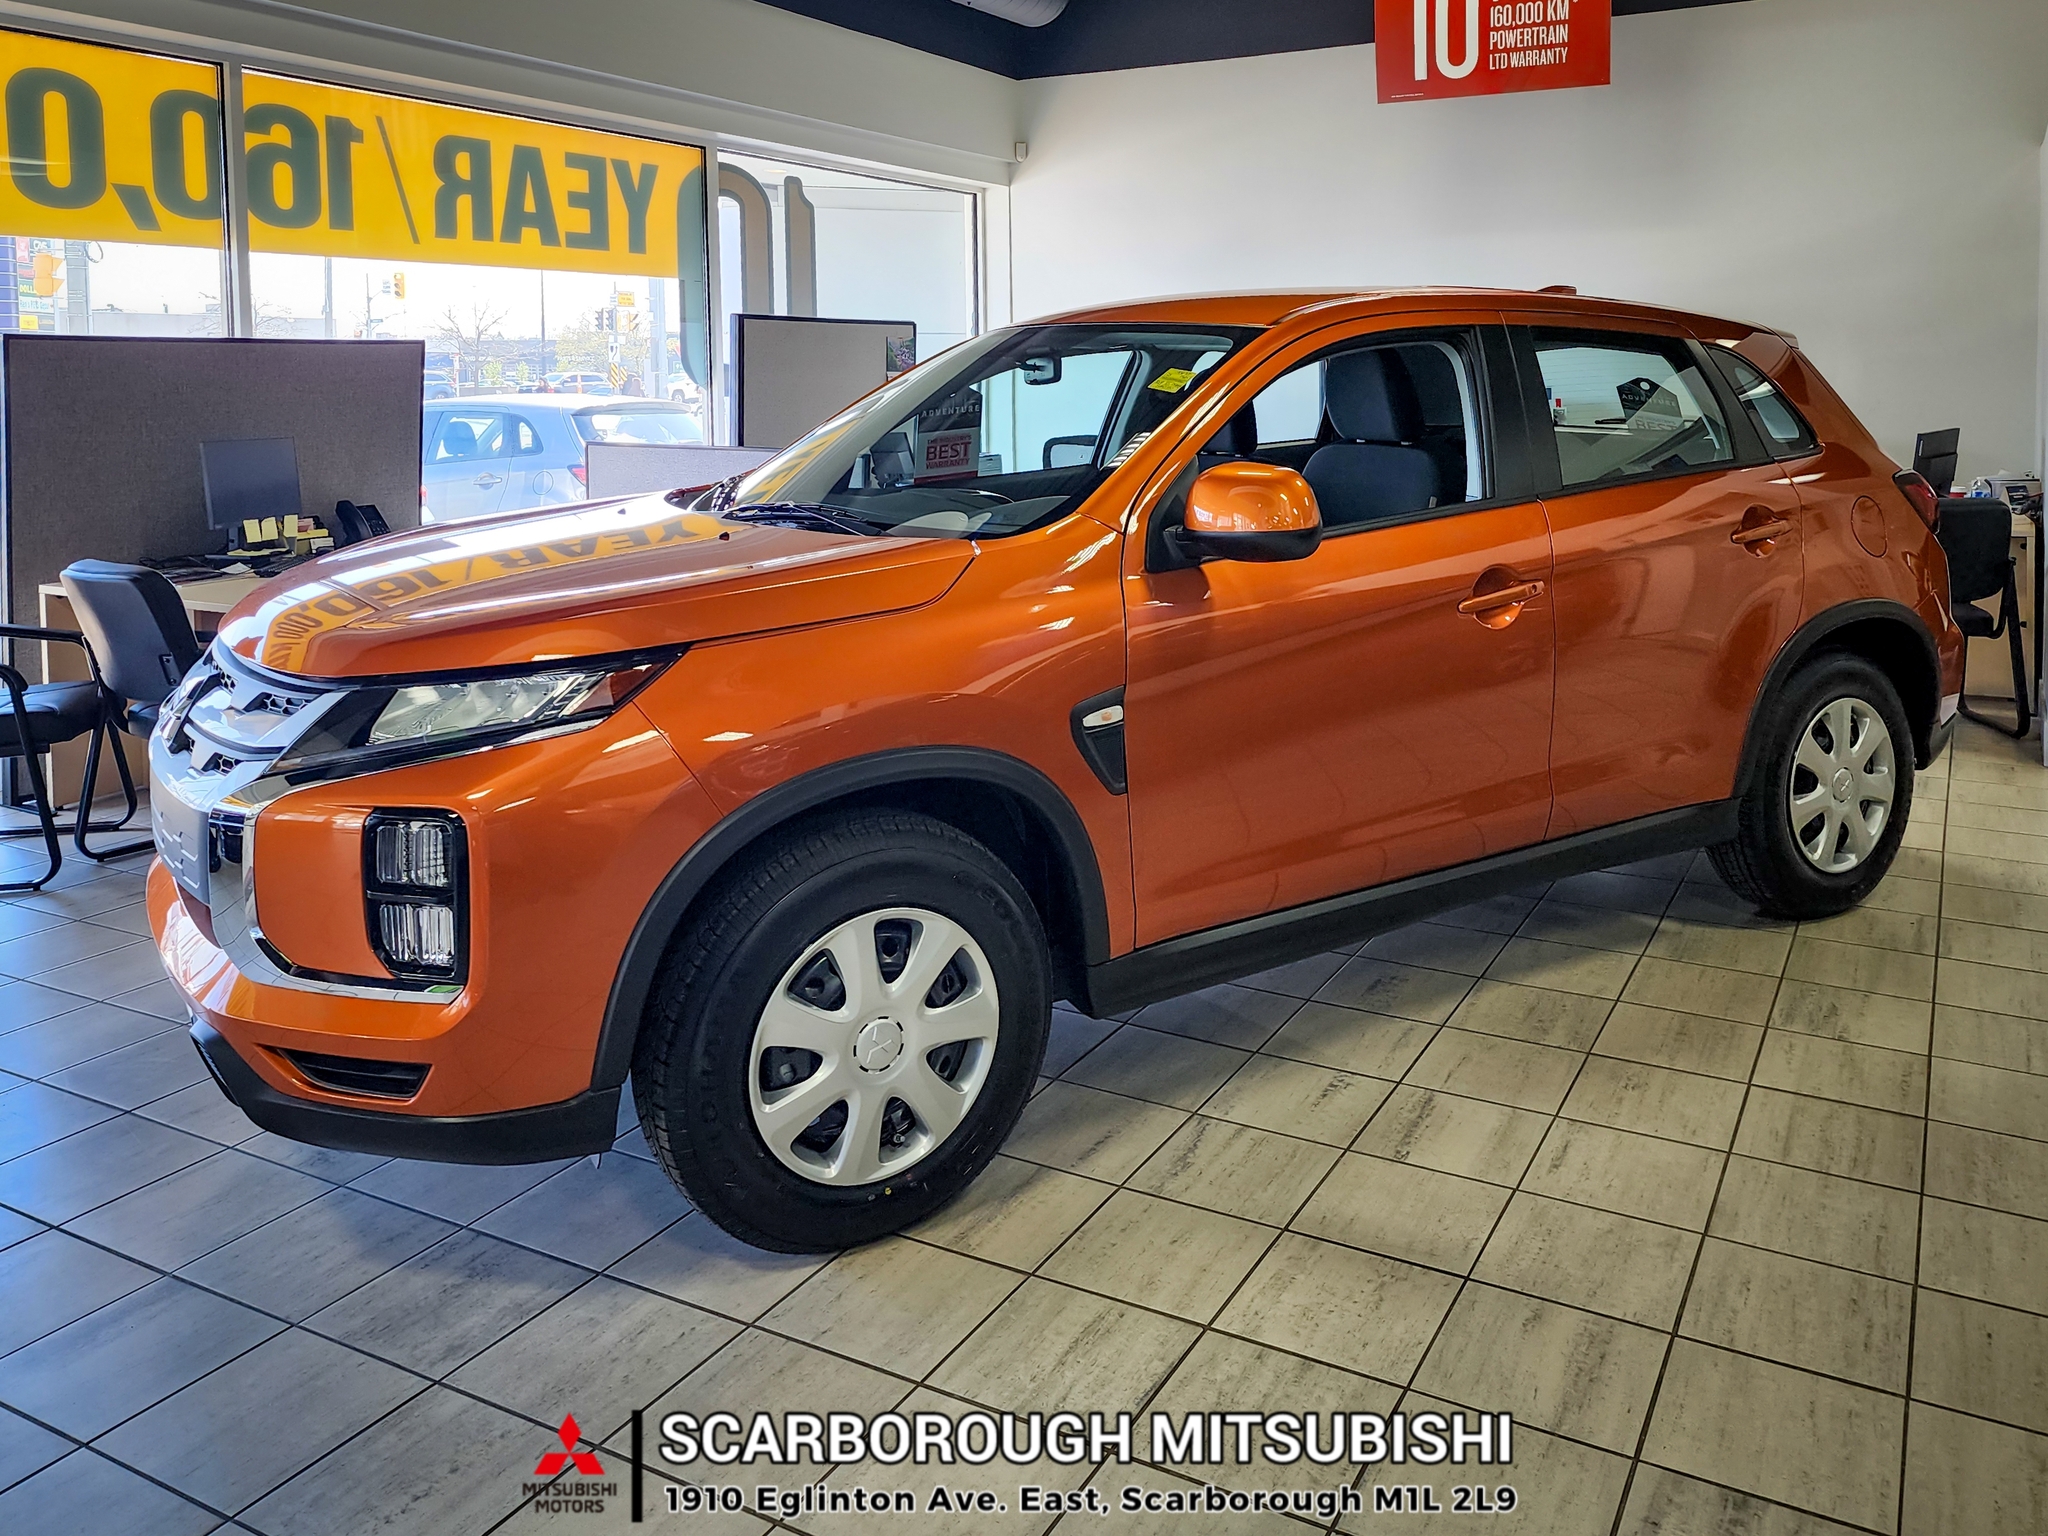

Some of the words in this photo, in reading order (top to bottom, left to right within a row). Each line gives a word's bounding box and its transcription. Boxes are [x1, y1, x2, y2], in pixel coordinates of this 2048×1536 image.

[1490, 1, 1544, 28] 160,000
[1489, 24, 1568, 50] POWERTRAIN
[1489, 53, 1508, 70] LTD
[1510, 47, 1568, 68] WARRANTY
[921, 405, 980, 418] ADVENTURE
[926, 441, 972, 461] BEST
[926, 458, 970, 469] WARRANTY
